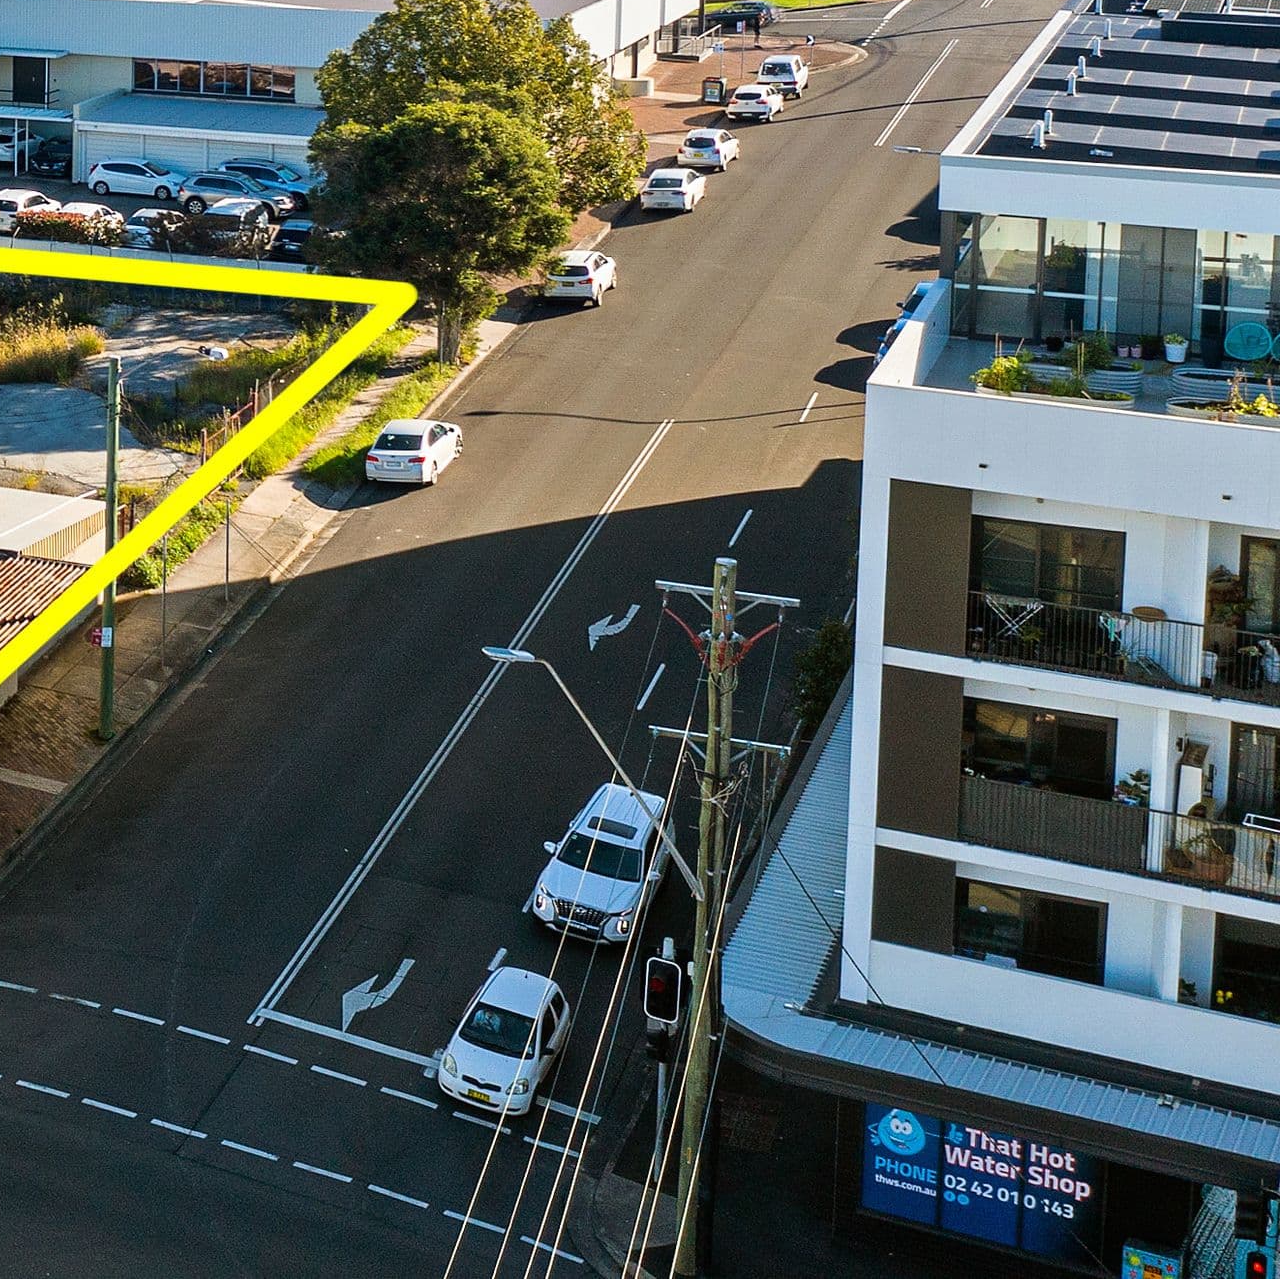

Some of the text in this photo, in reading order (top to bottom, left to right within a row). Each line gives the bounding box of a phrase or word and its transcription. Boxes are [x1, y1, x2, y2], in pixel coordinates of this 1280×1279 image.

[965, 1127, 1076, 1172] That Hot
[874, 1155, 937, 1184] PHONE
[944, 1174, 967, 1192] 02
[970, 1181, 993, 1199] 42
[874, 1173, 937, 1197] thws.com.au
[944, 1144, 1091, 1201] Water Shop
